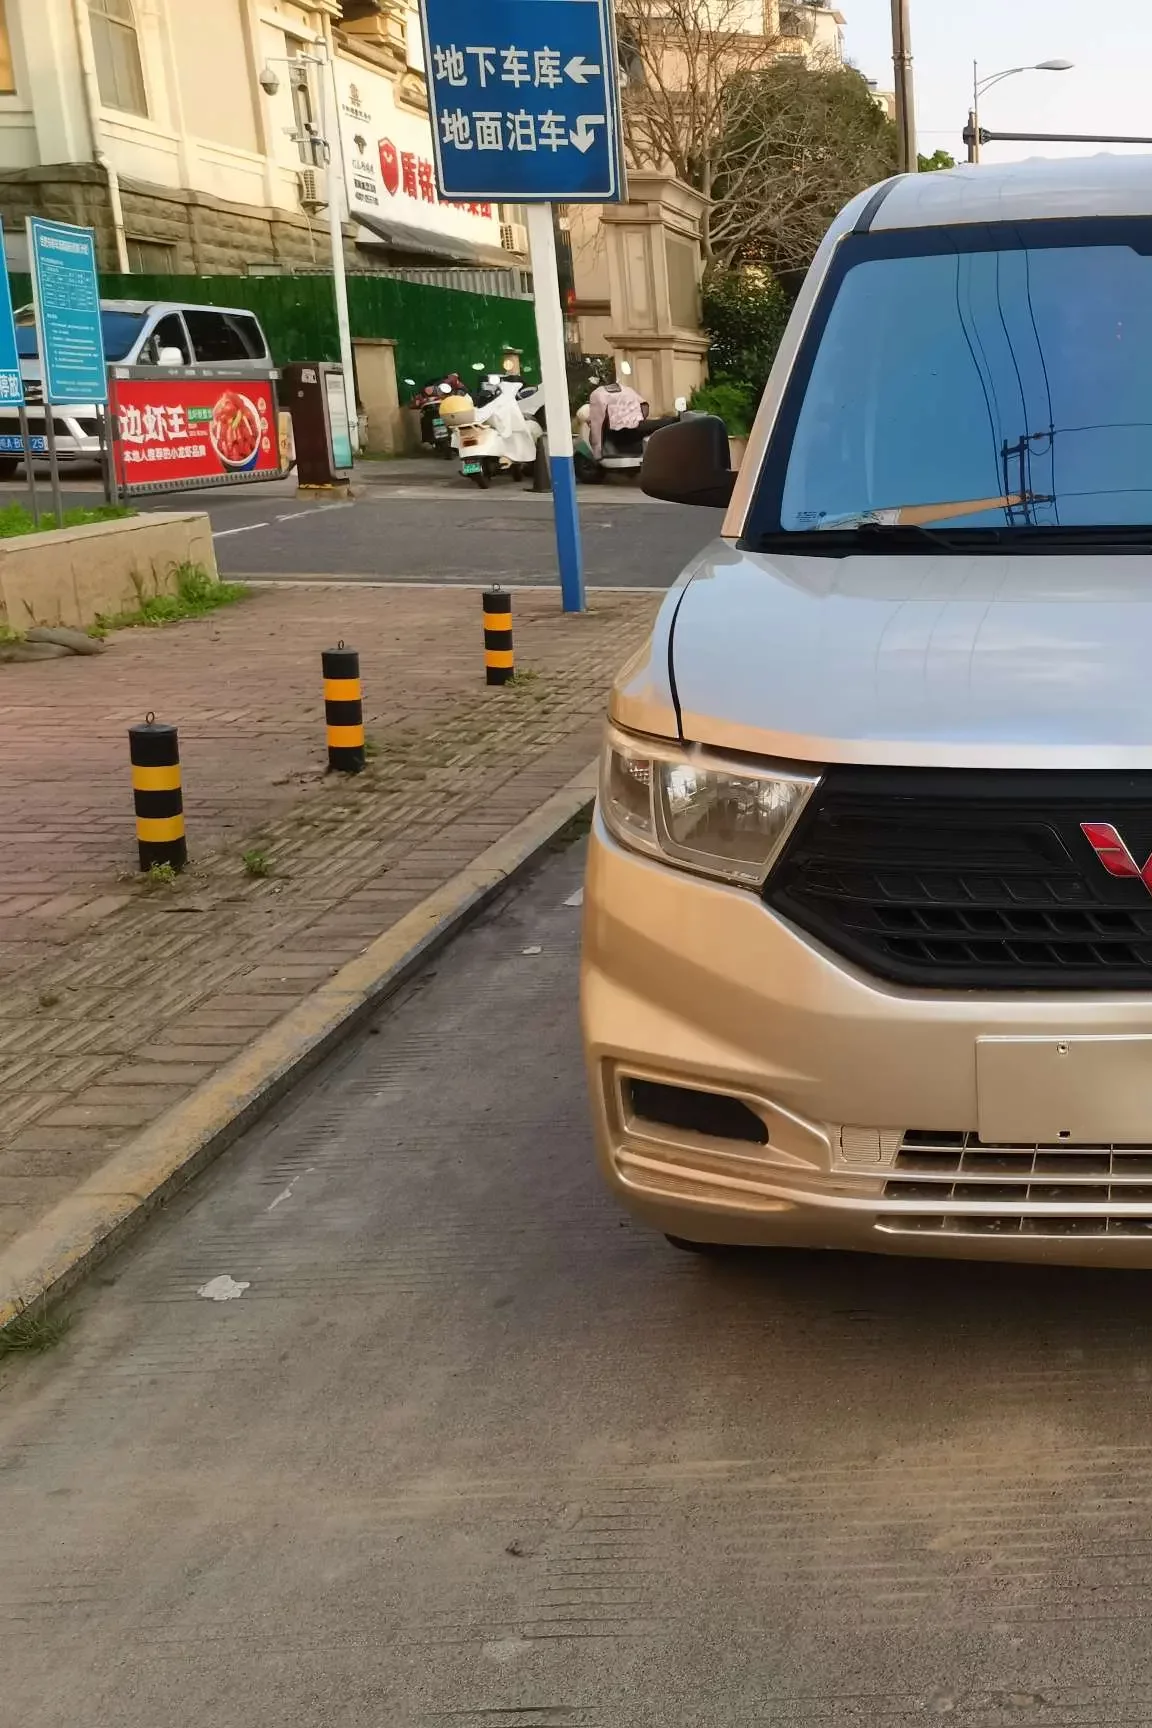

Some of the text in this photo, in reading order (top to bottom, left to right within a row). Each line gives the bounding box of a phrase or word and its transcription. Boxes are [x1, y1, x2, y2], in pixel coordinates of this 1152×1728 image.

[434, 44, 563, 88] 地下车库
[441, 108, 569, 152] 地面泊车
[119, 404, 188, 443] 边虾王
